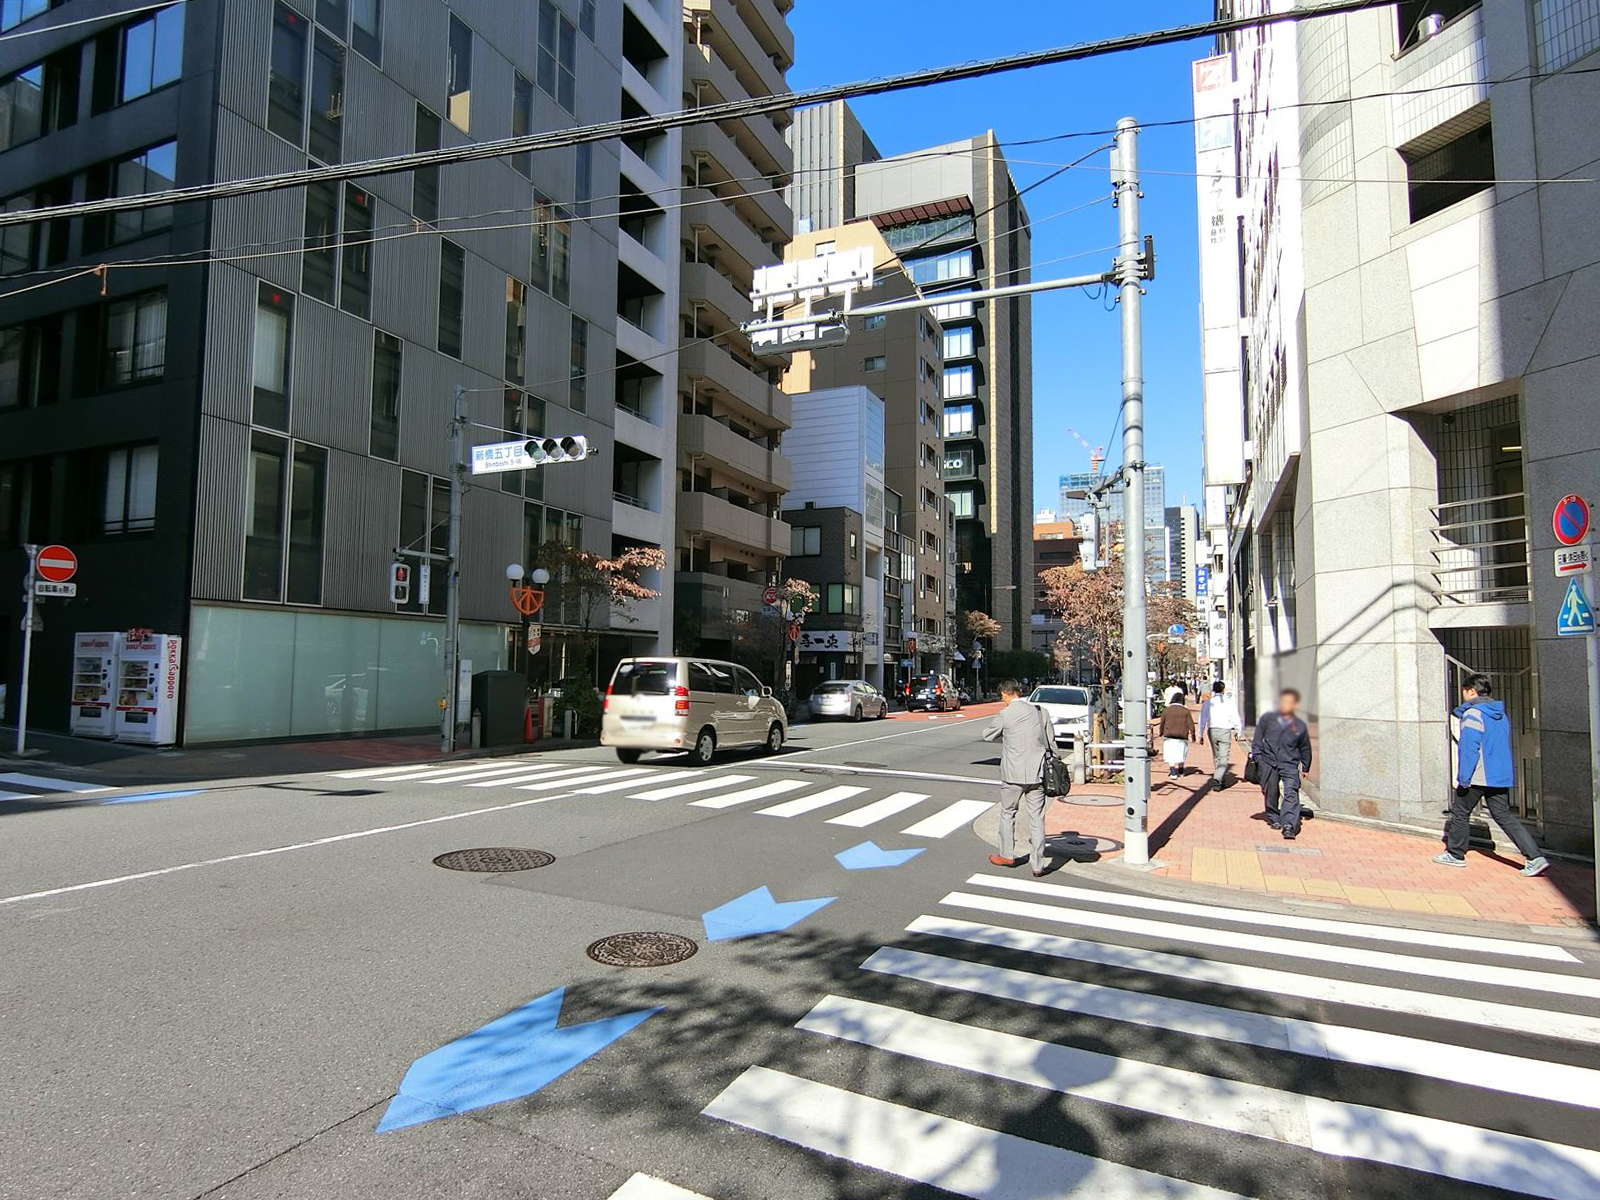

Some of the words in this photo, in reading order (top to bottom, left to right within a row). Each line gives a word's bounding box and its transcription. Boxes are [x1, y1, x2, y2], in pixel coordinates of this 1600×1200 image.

[476, 445, 528, 460] 新橋五丁目
